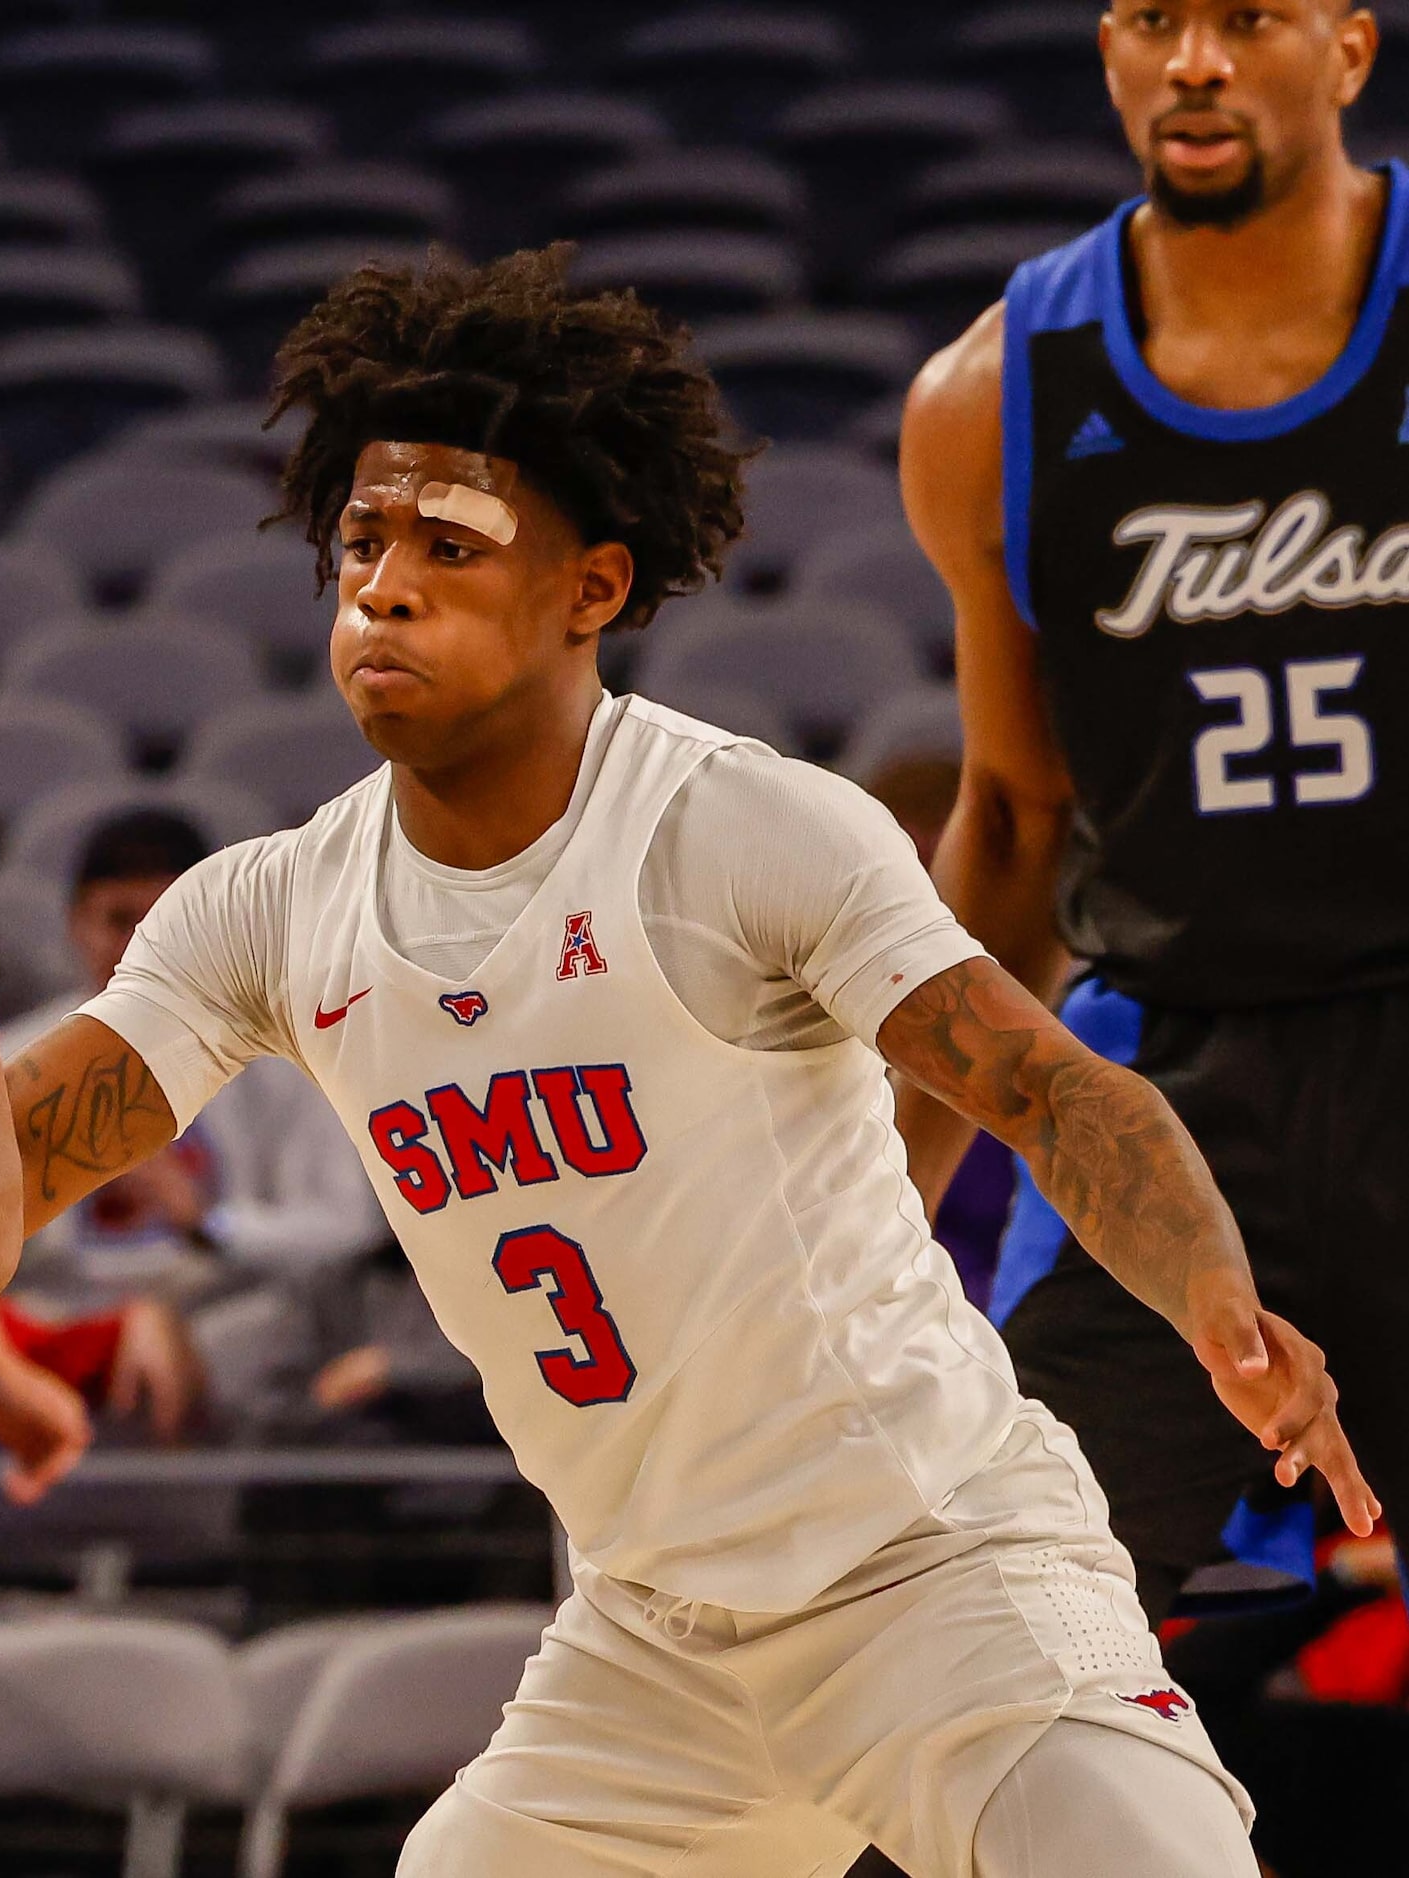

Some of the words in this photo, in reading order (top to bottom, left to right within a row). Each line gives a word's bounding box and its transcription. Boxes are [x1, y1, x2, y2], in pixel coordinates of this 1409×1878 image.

[1189, 655, 1375, 814] 25
[556, 911, 607, 981] A
[368, 1063, 648, 1214] SMU
[493, 1224, 638, 1407] 3
